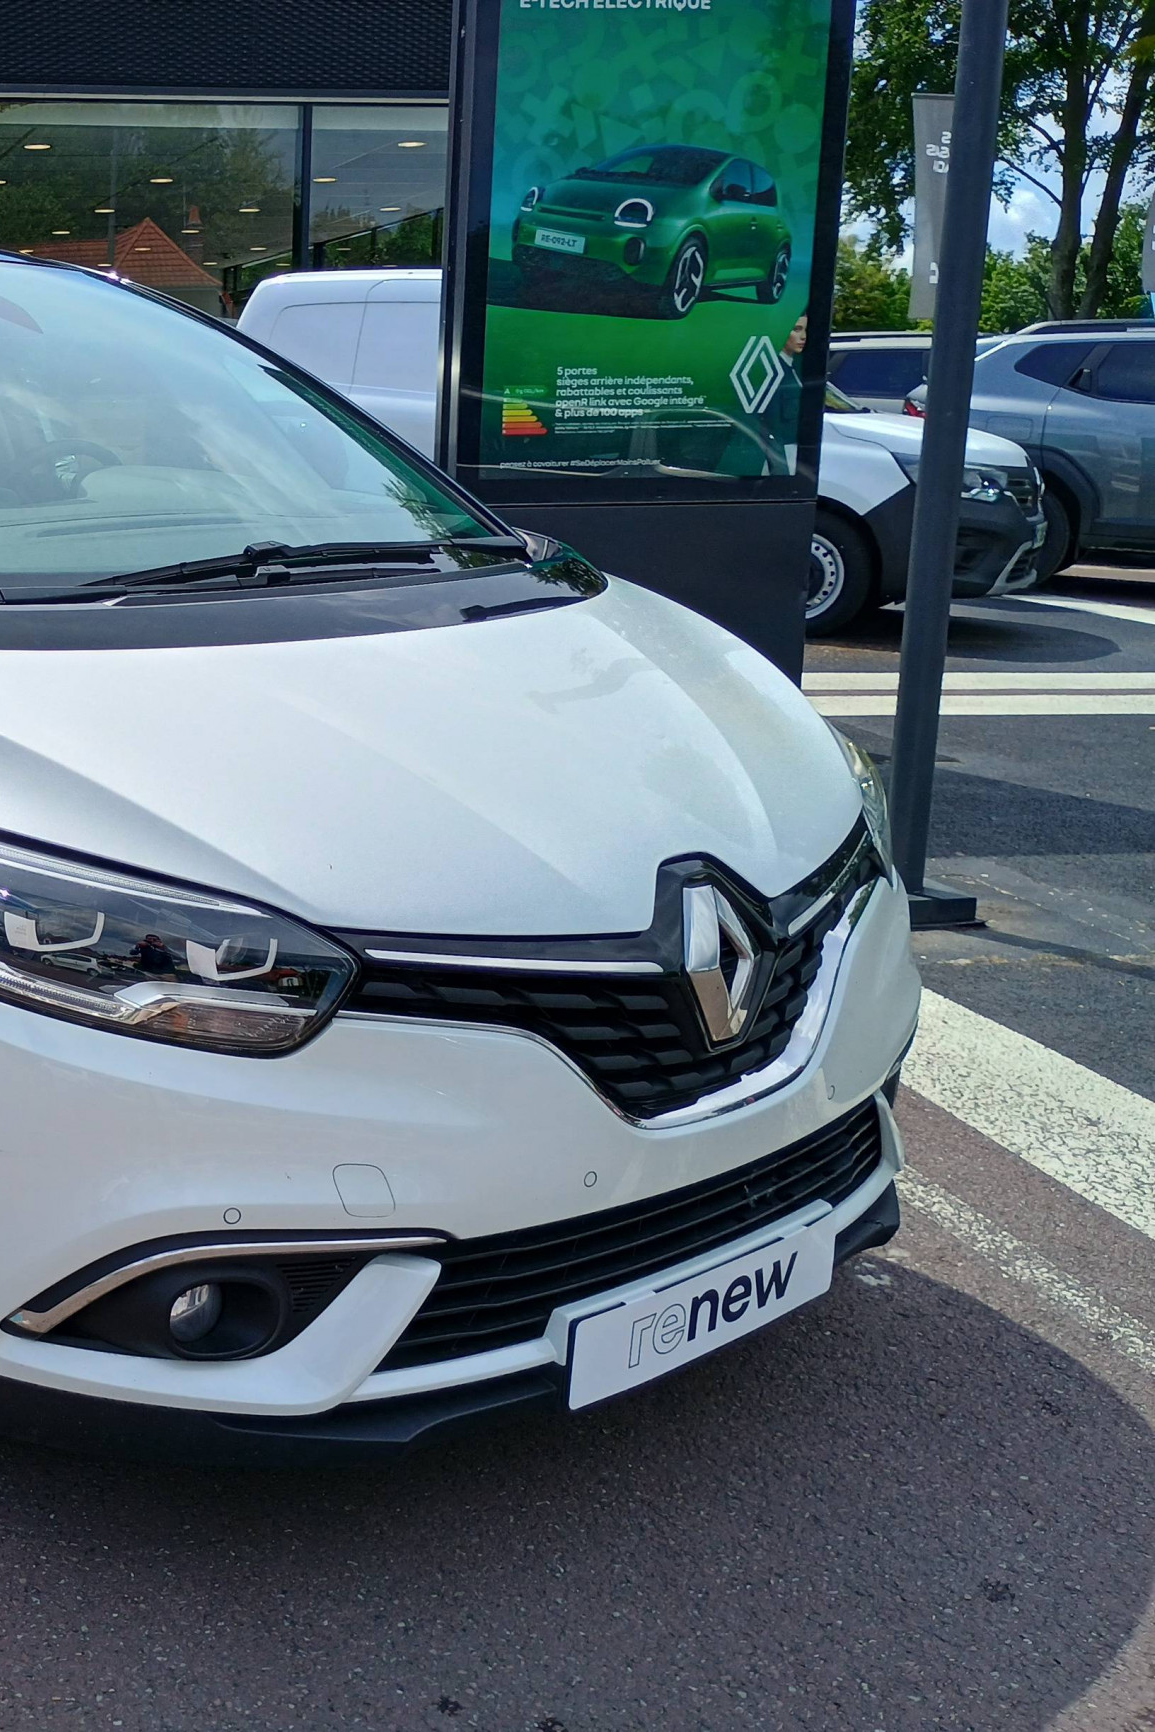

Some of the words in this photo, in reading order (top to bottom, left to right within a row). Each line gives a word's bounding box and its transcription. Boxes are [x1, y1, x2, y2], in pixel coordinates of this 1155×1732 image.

[557, 366, 563, 375] 5
[564, 367, 597, 378] portes
[556, 376, 589, 388] sièges
[590, 375, 623, 385] arrière
[624, 375, 694, 387] indépendants,
[555, 385, 615, 396] rabattables
[616, 387, 626, 396] et
[627, 385, 683, 396] coulissants
[555, 396, 587, 408] openR
[589, 396, 607, 407] link
[608, 397, 632, 407] avec
[633, 396, 668, 408] Google
[554, 407, 563, 417] &
[564, 407, 585, 419] plus
[586, 407, 599, 417] de
[601, 407, 617, 417] 100
[618, 408, 644, 418] apps
[628, 1251, 798, 1368] renew
